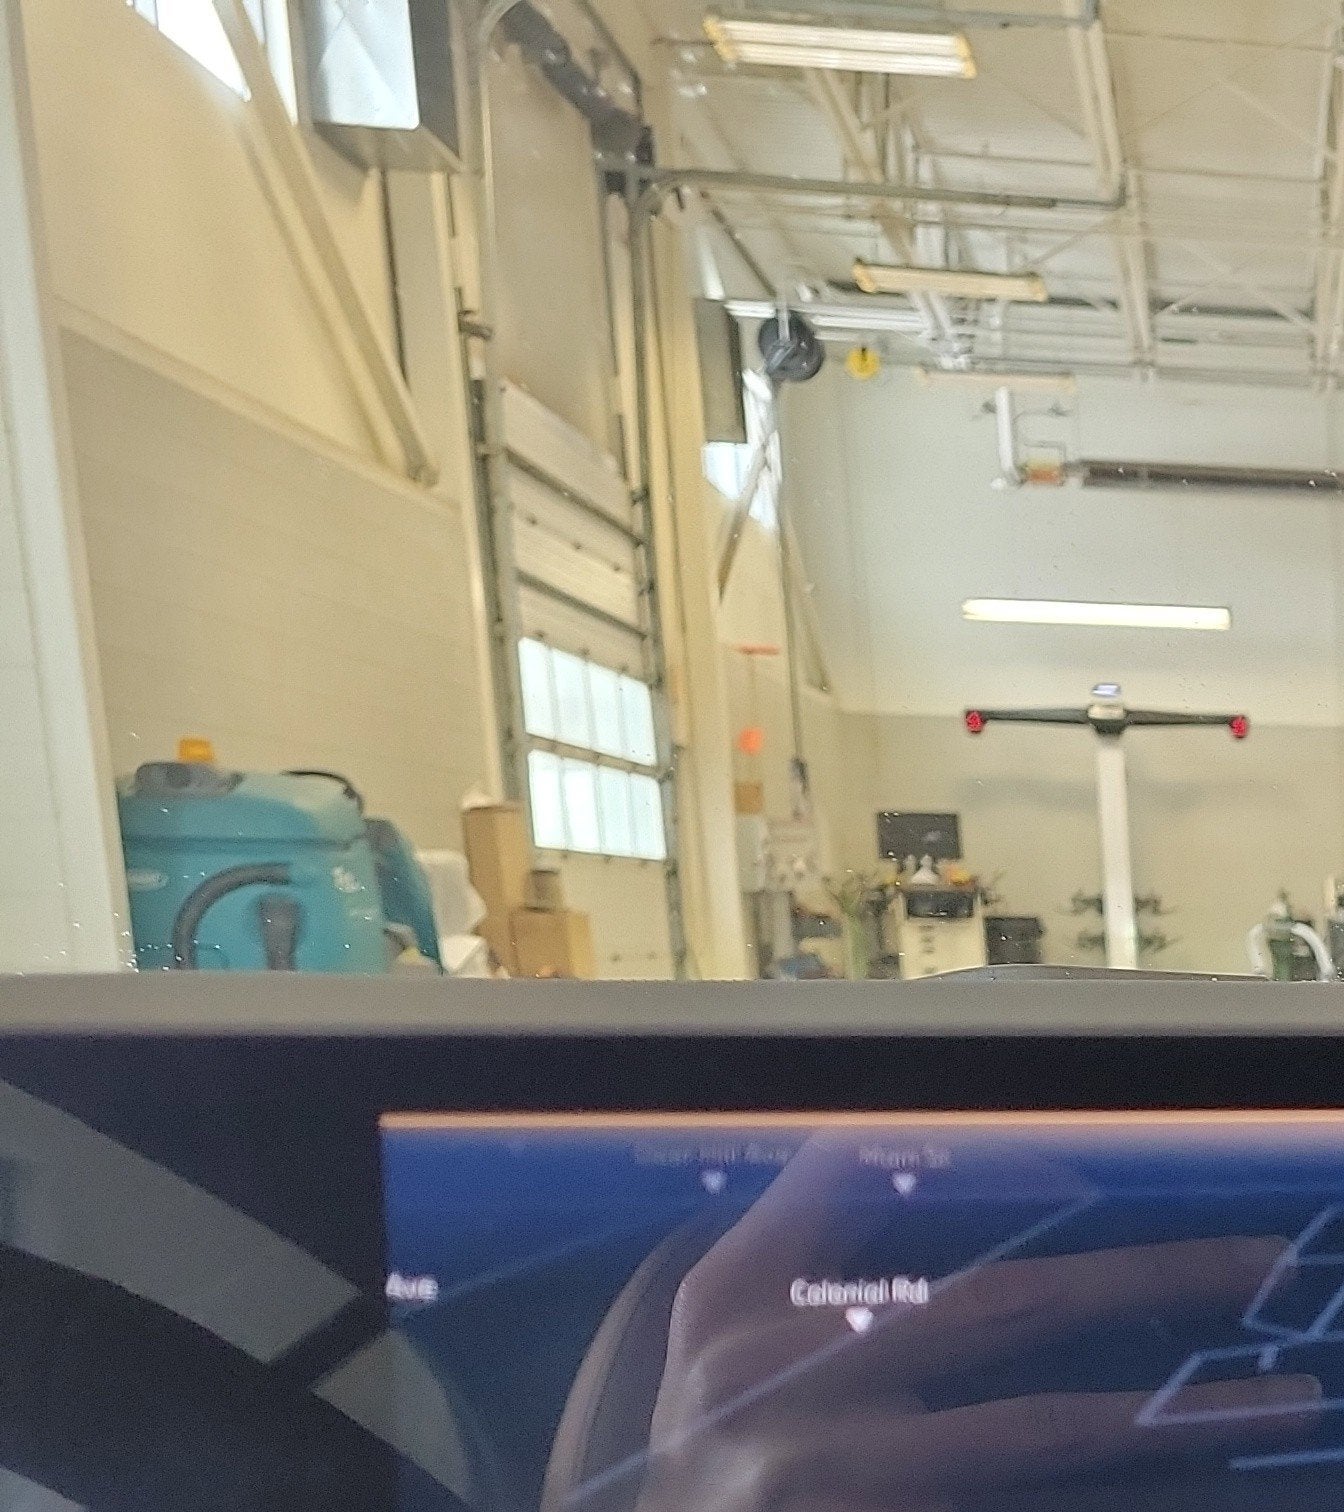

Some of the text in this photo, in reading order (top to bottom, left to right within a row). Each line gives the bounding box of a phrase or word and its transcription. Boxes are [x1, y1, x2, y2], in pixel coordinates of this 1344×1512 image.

[386, 1273, 438, 1301] Ave
[790, 1276, 928, 1306] Colonial Rd
